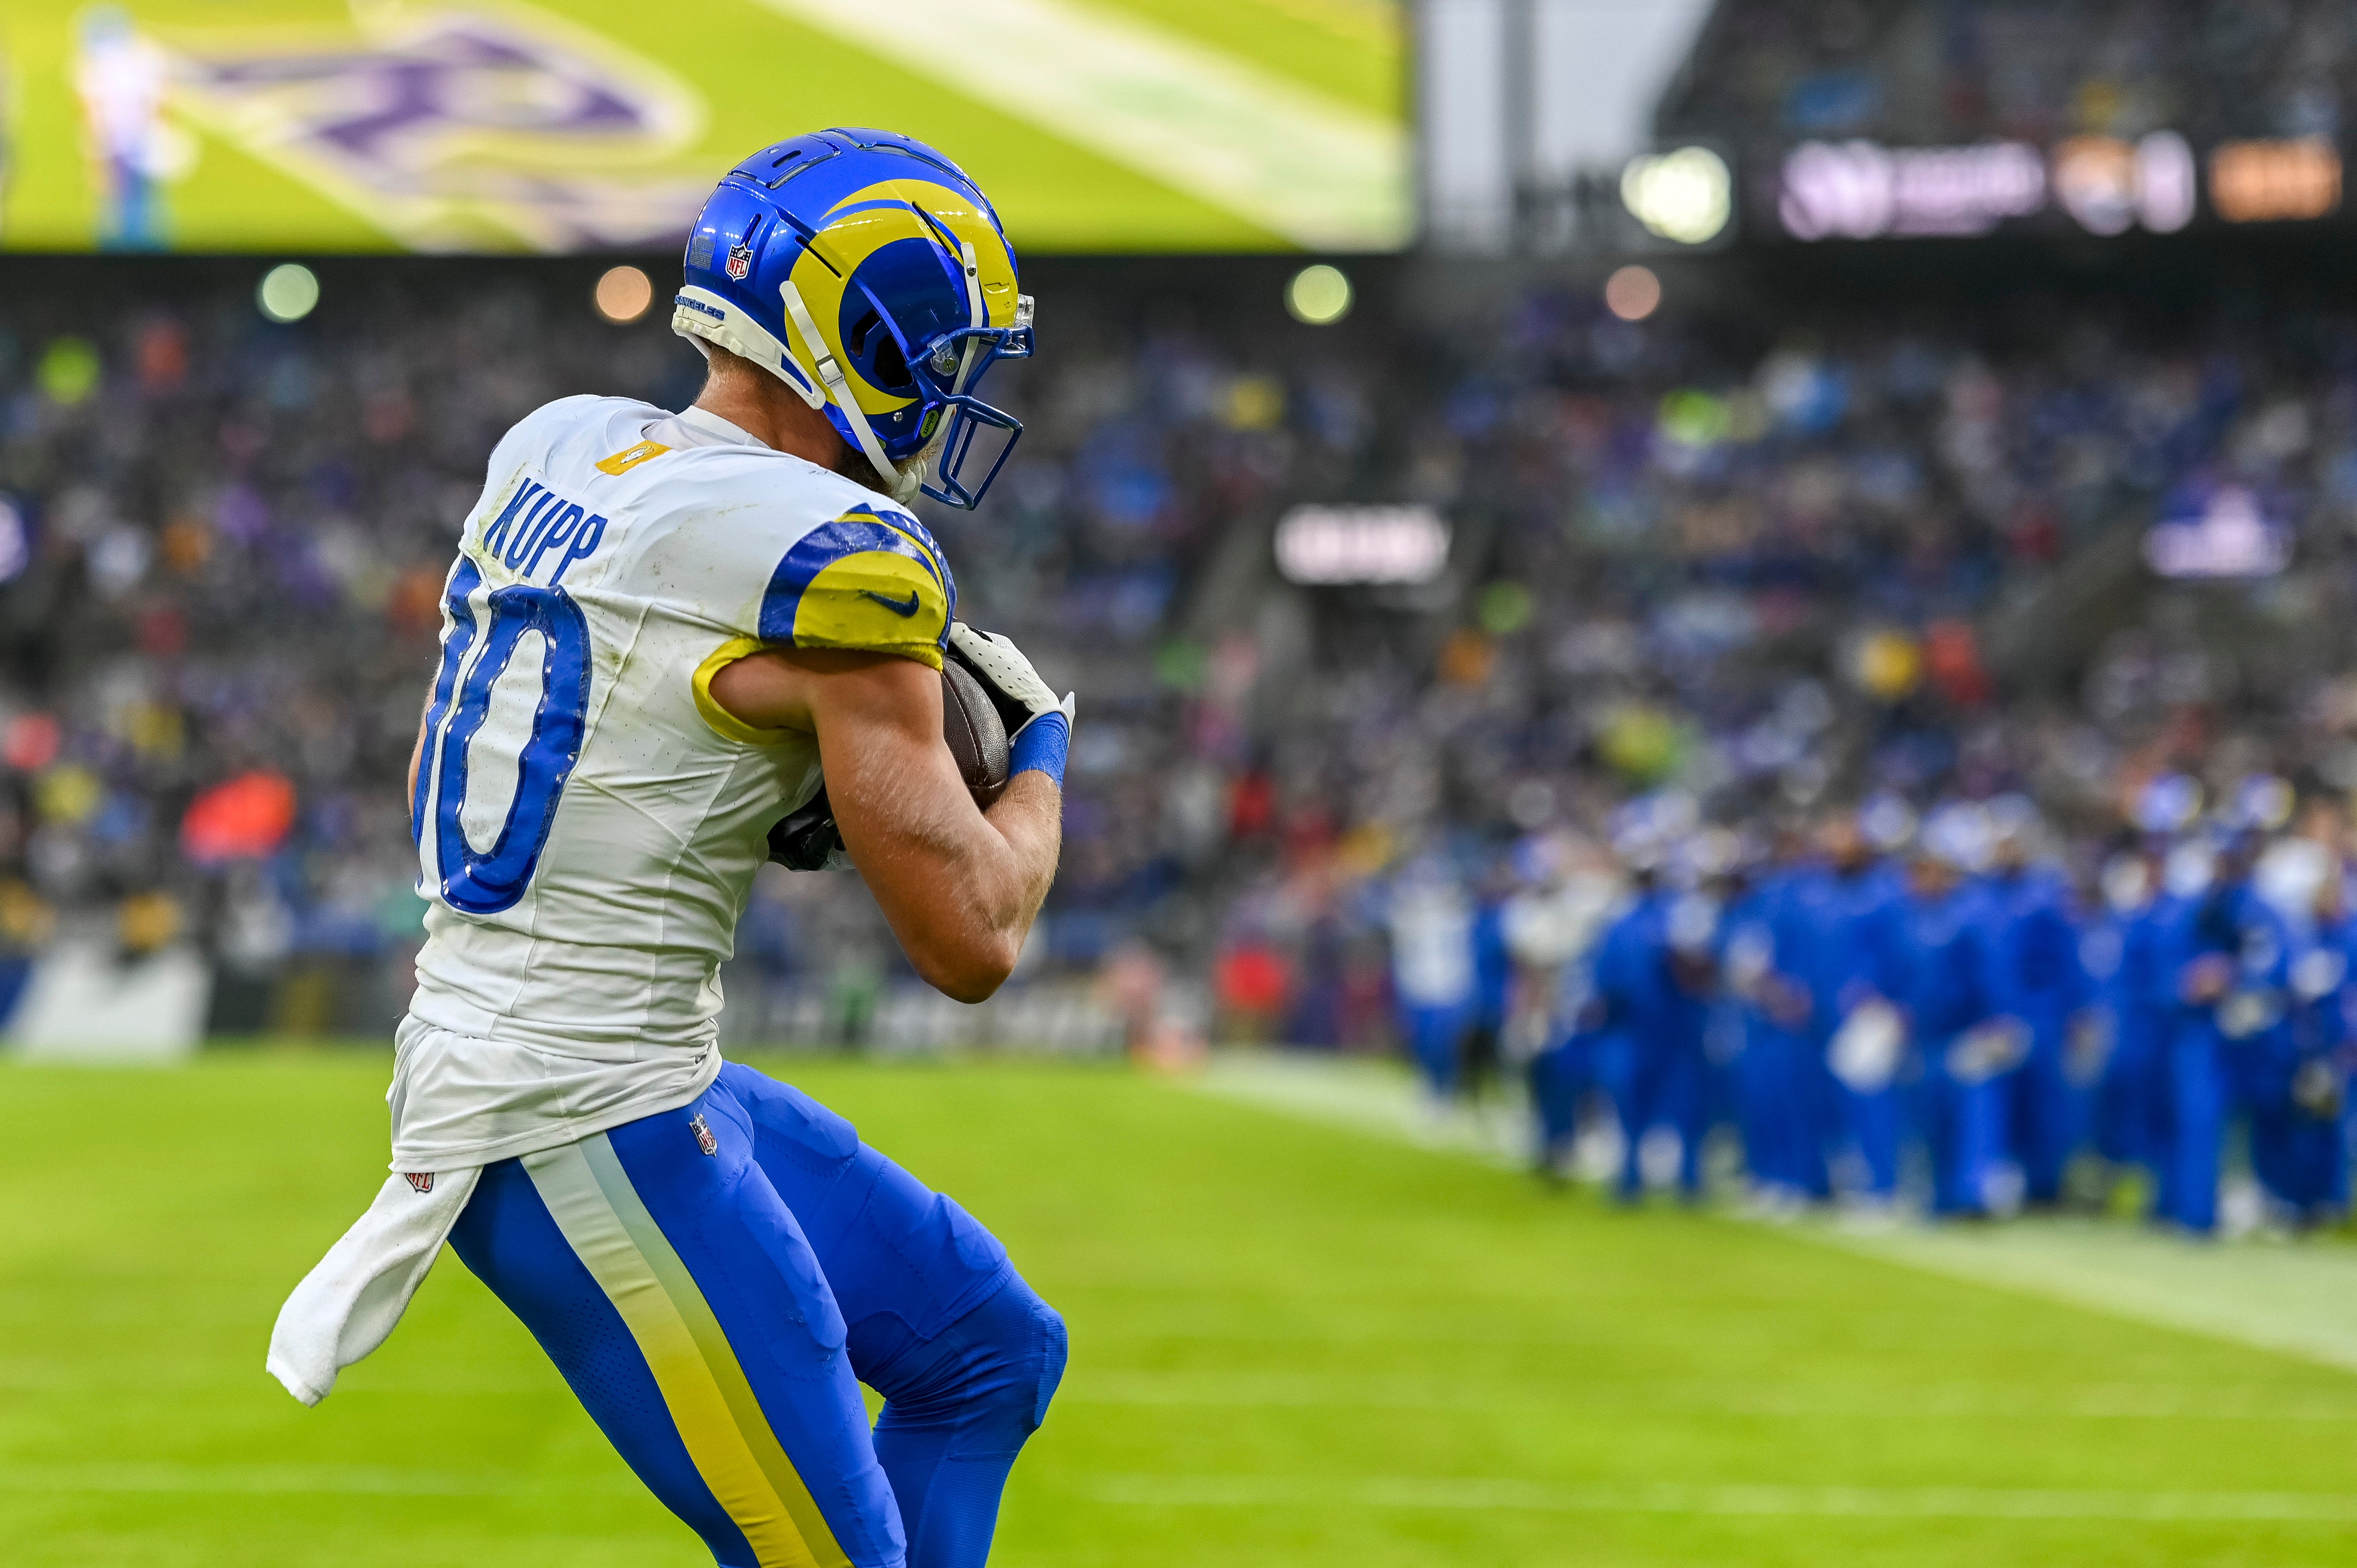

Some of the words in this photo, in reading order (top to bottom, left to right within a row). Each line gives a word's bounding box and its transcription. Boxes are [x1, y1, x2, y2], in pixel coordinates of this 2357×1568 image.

[728, 257, 745, 275] NFL
[483, 477, 608, 587] KUPP
[412, 554, 592, 914] 10
